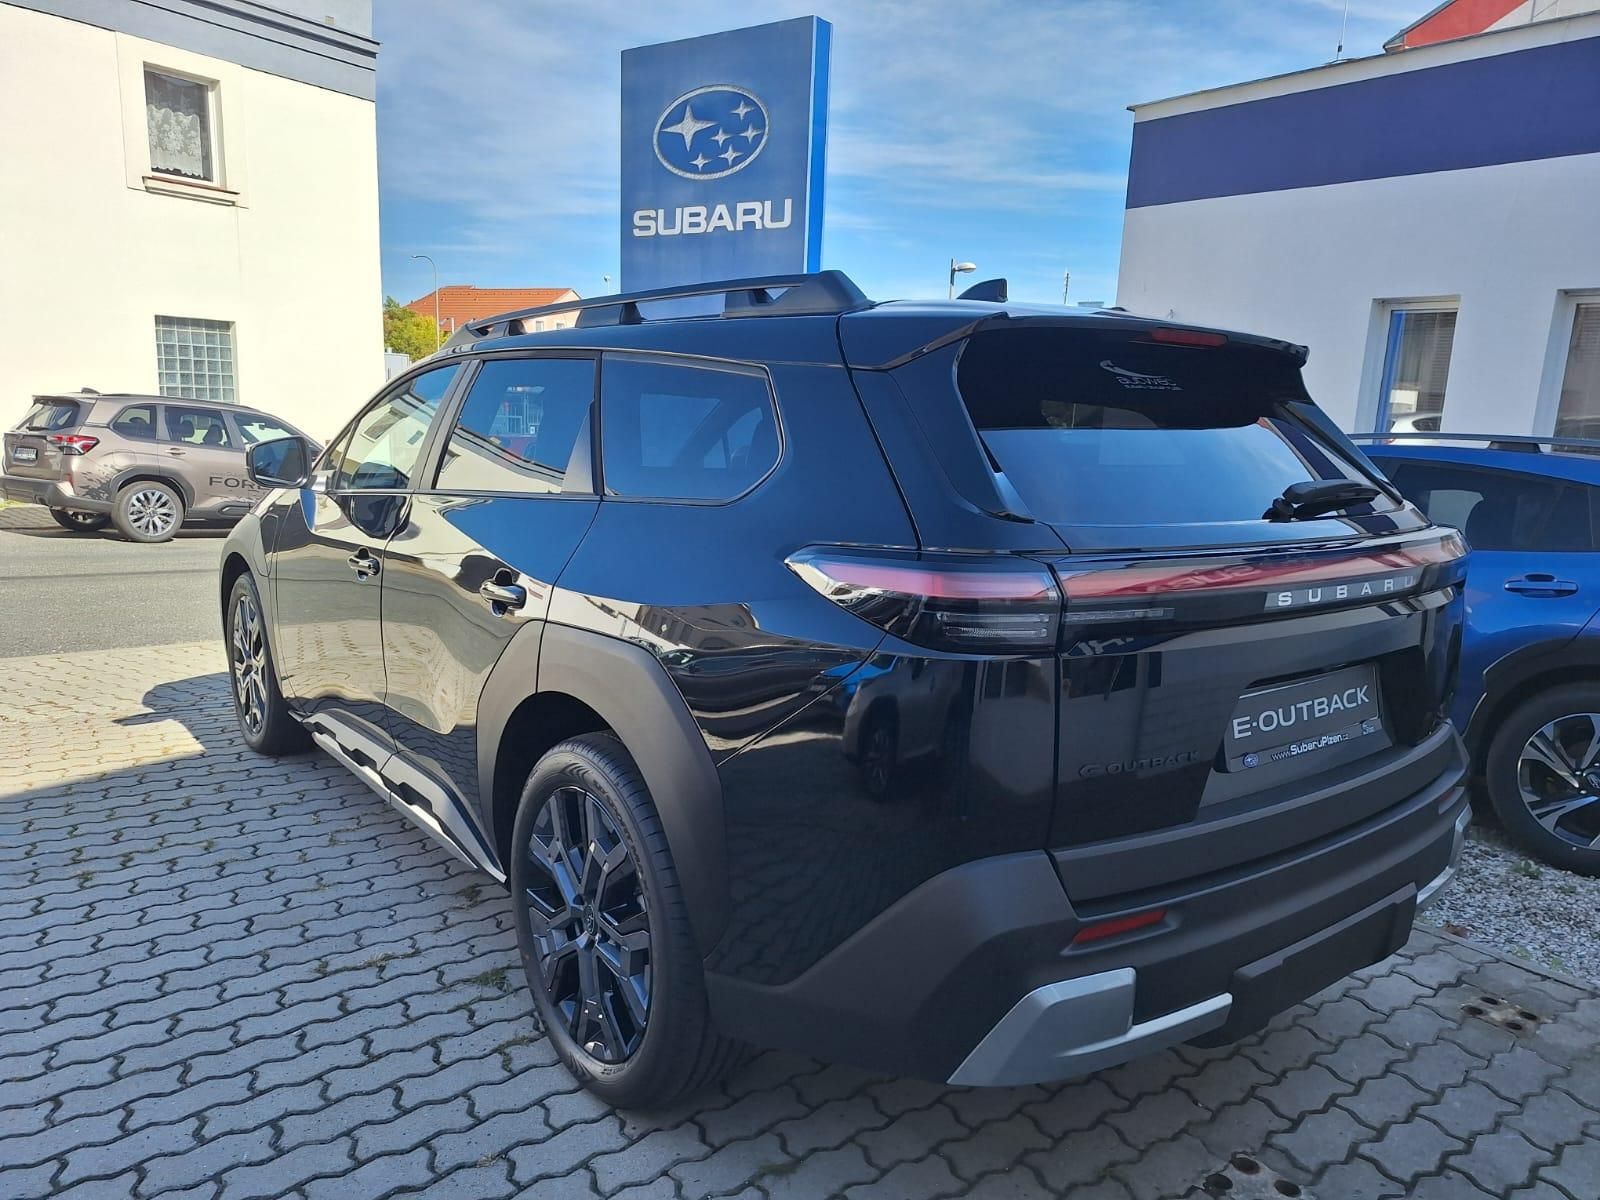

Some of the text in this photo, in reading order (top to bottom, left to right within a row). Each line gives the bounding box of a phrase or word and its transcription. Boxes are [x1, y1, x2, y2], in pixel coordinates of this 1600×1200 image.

[632, 198, 793, 237] SUBARU
[209, 476, 260, 490] FOR
[1278, 575, 1414, 606] SUBARU
[1105, 751, 1199, 775] OUTBACK
